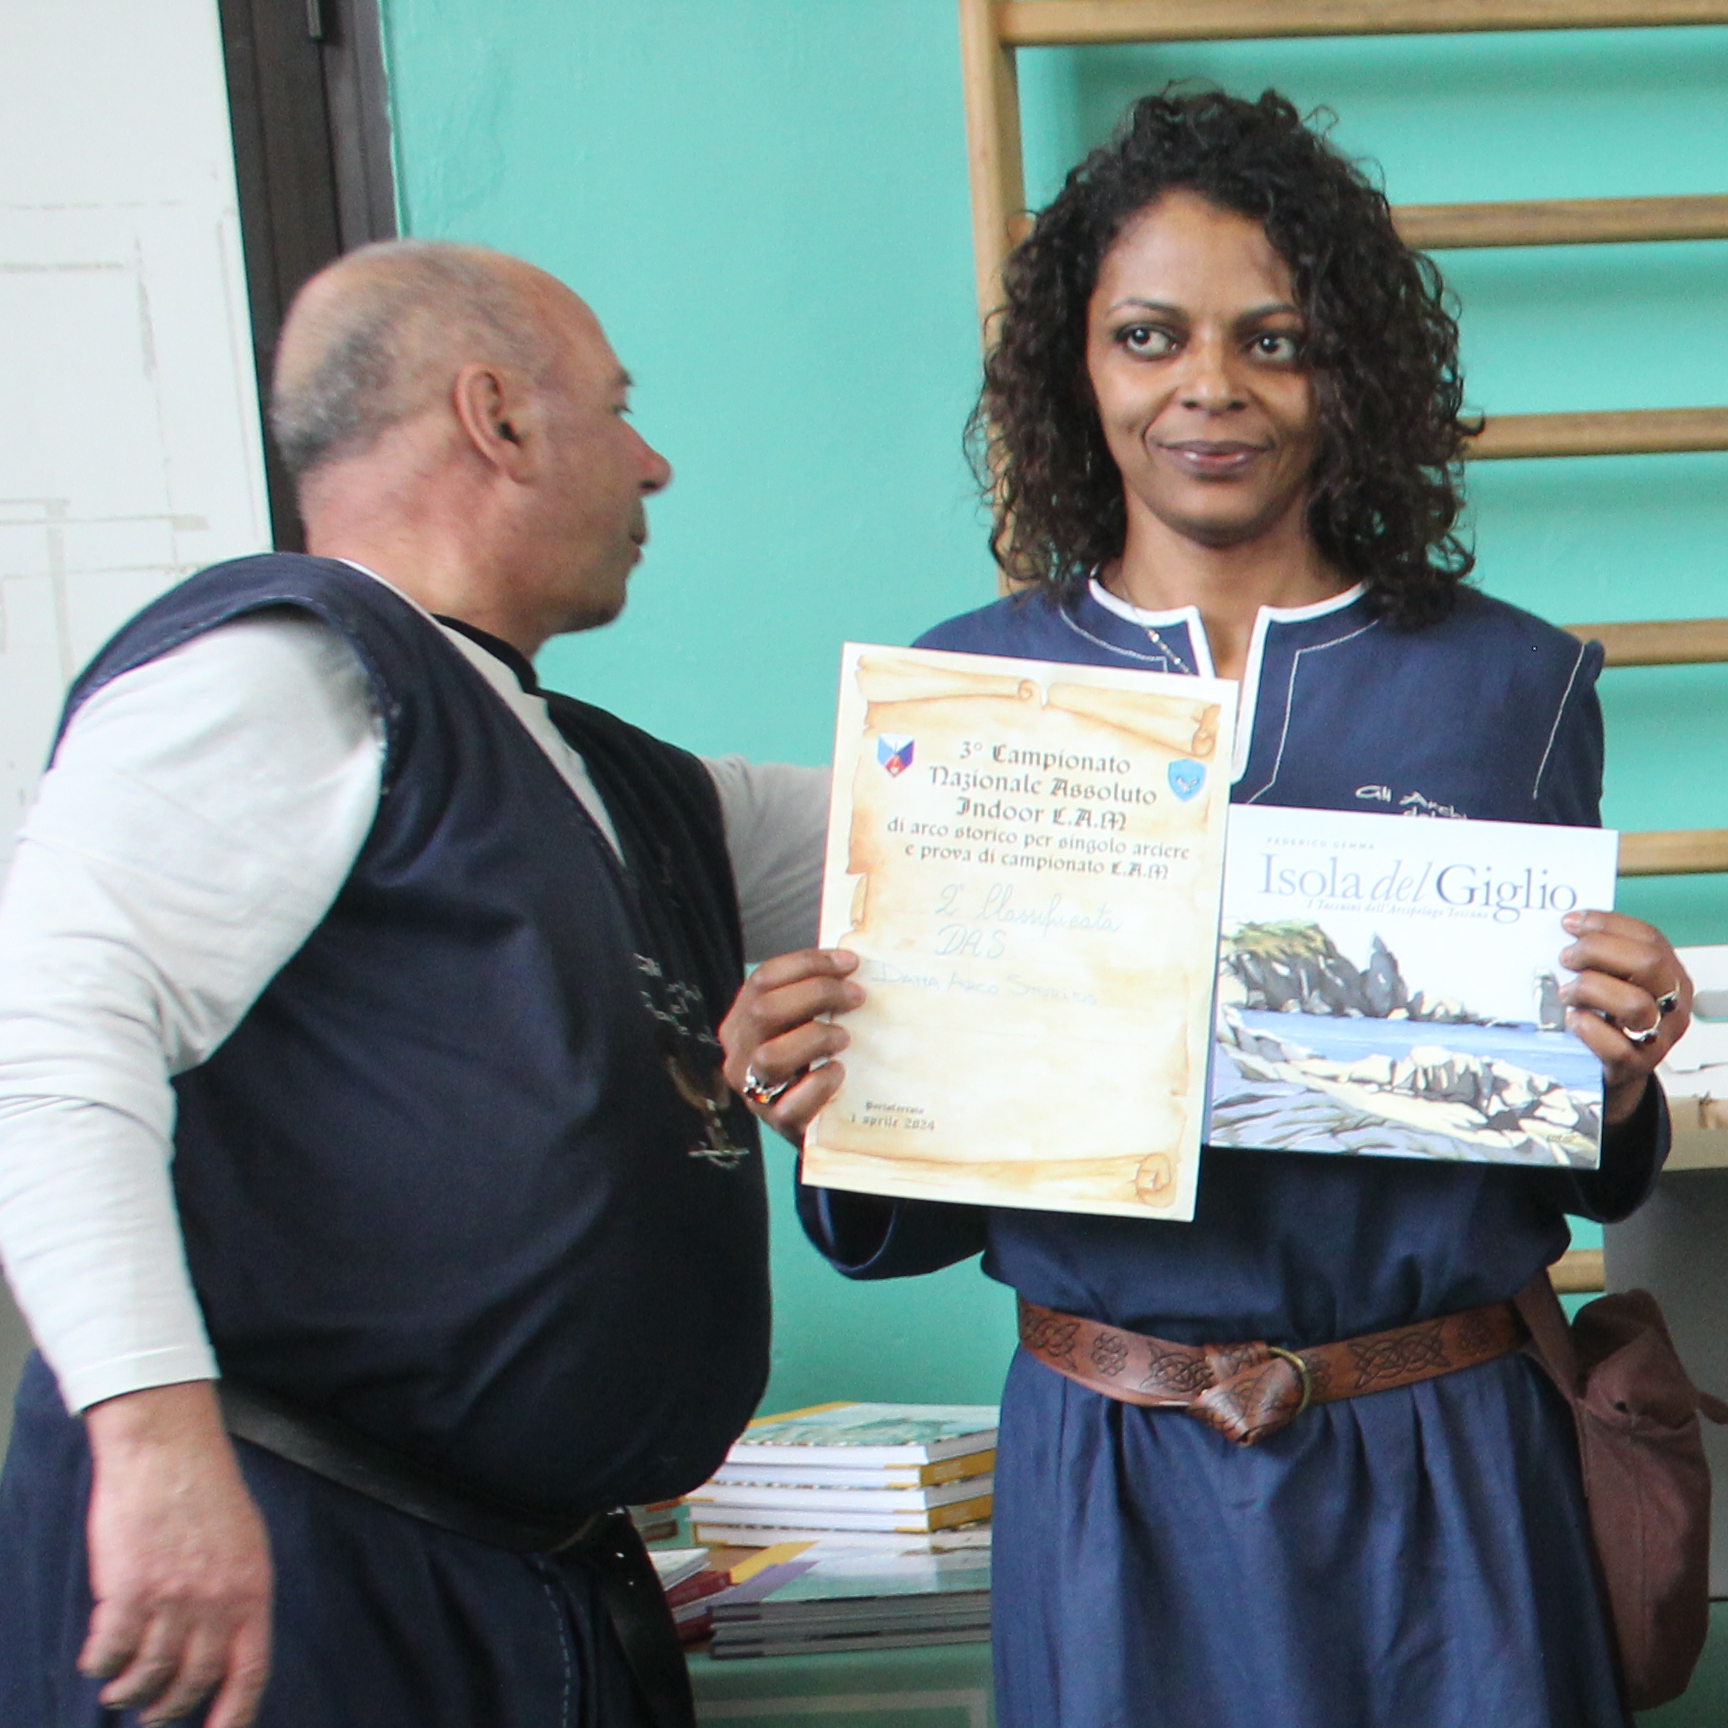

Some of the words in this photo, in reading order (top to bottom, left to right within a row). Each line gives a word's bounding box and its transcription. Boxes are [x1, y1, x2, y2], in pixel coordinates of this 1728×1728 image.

[992, 743, 1131, 775] Campionato
[929, 766, 1041, 795] Nazionale
[1049, 777, 1158, 806] Assoluto
[956, 796, 1044, 823] Indoor
[887, 817, 905, 833] di
[911, 821, 949, 837] arco
[954, 826, 1018, 844] storico
[1024, 832, 1053, 849] per
[1058, 836, 1127, 856] singolo
[1132, 843, 1191, 860] arciere
[905, 845, 914, 856] e
[920, 846, 972, 863] prova
[978, 850, 995, 864] di
[1001, 853, 1105, 875] campionato
[1257, 852, 1363, 900] Isola
[1370, 859, 1434, 903] del
[1436, 864, 1578, 924] Giglio
[936, 924, 1006, 958] DAS
[862, 1116, 898, 1129] aprile
